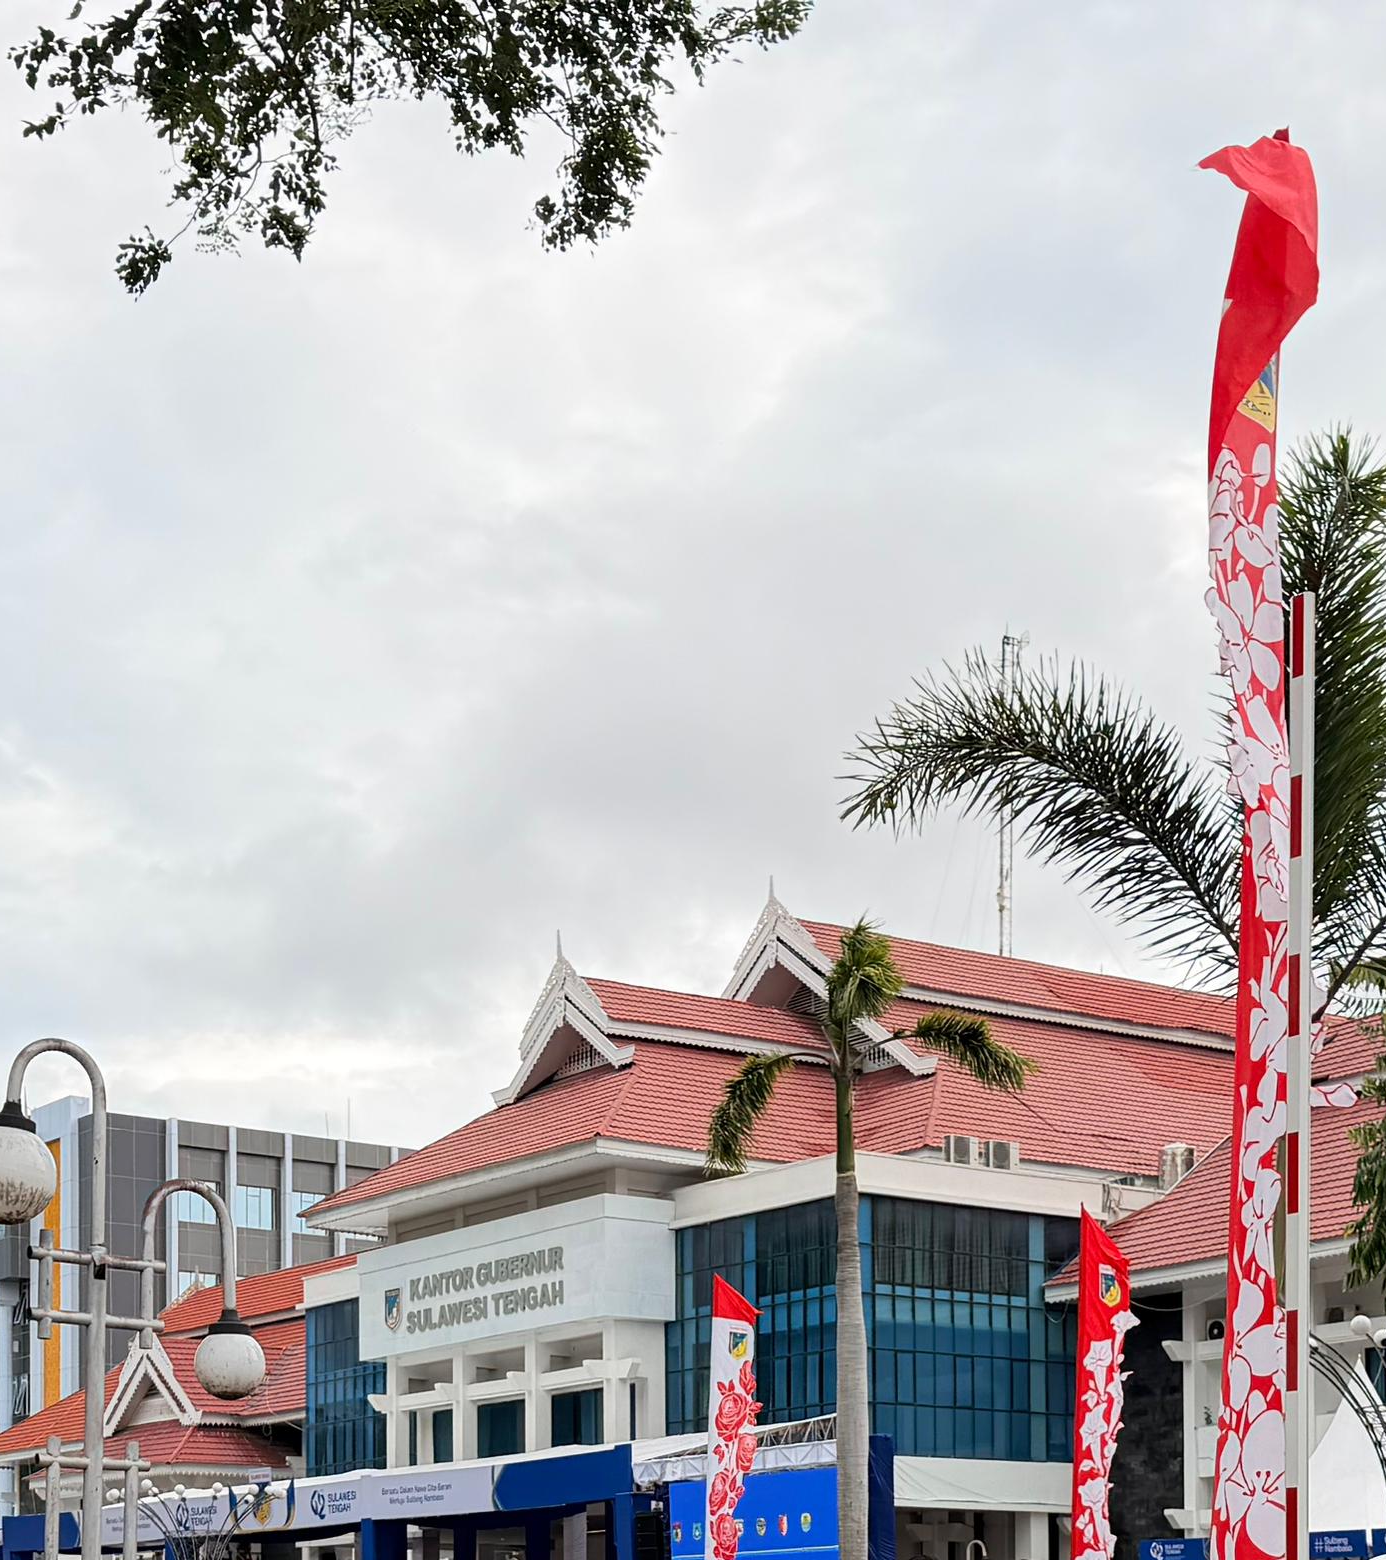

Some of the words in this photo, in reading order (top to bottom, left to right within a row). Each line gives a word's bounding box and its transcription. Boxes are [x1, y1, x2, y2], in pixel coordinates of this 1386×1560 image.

[409, 1266, 474, 1301] KANTOR
[475, 1246, 564, 1287] GUBERNUR
[406, 1295, 488, 1334] SULAWESI
[491, 1280, 564, 1316] TENGAH
[327, 1490, 357, 1503] SULAWESI
[327, 1502, 352, 1514] TENGAH
